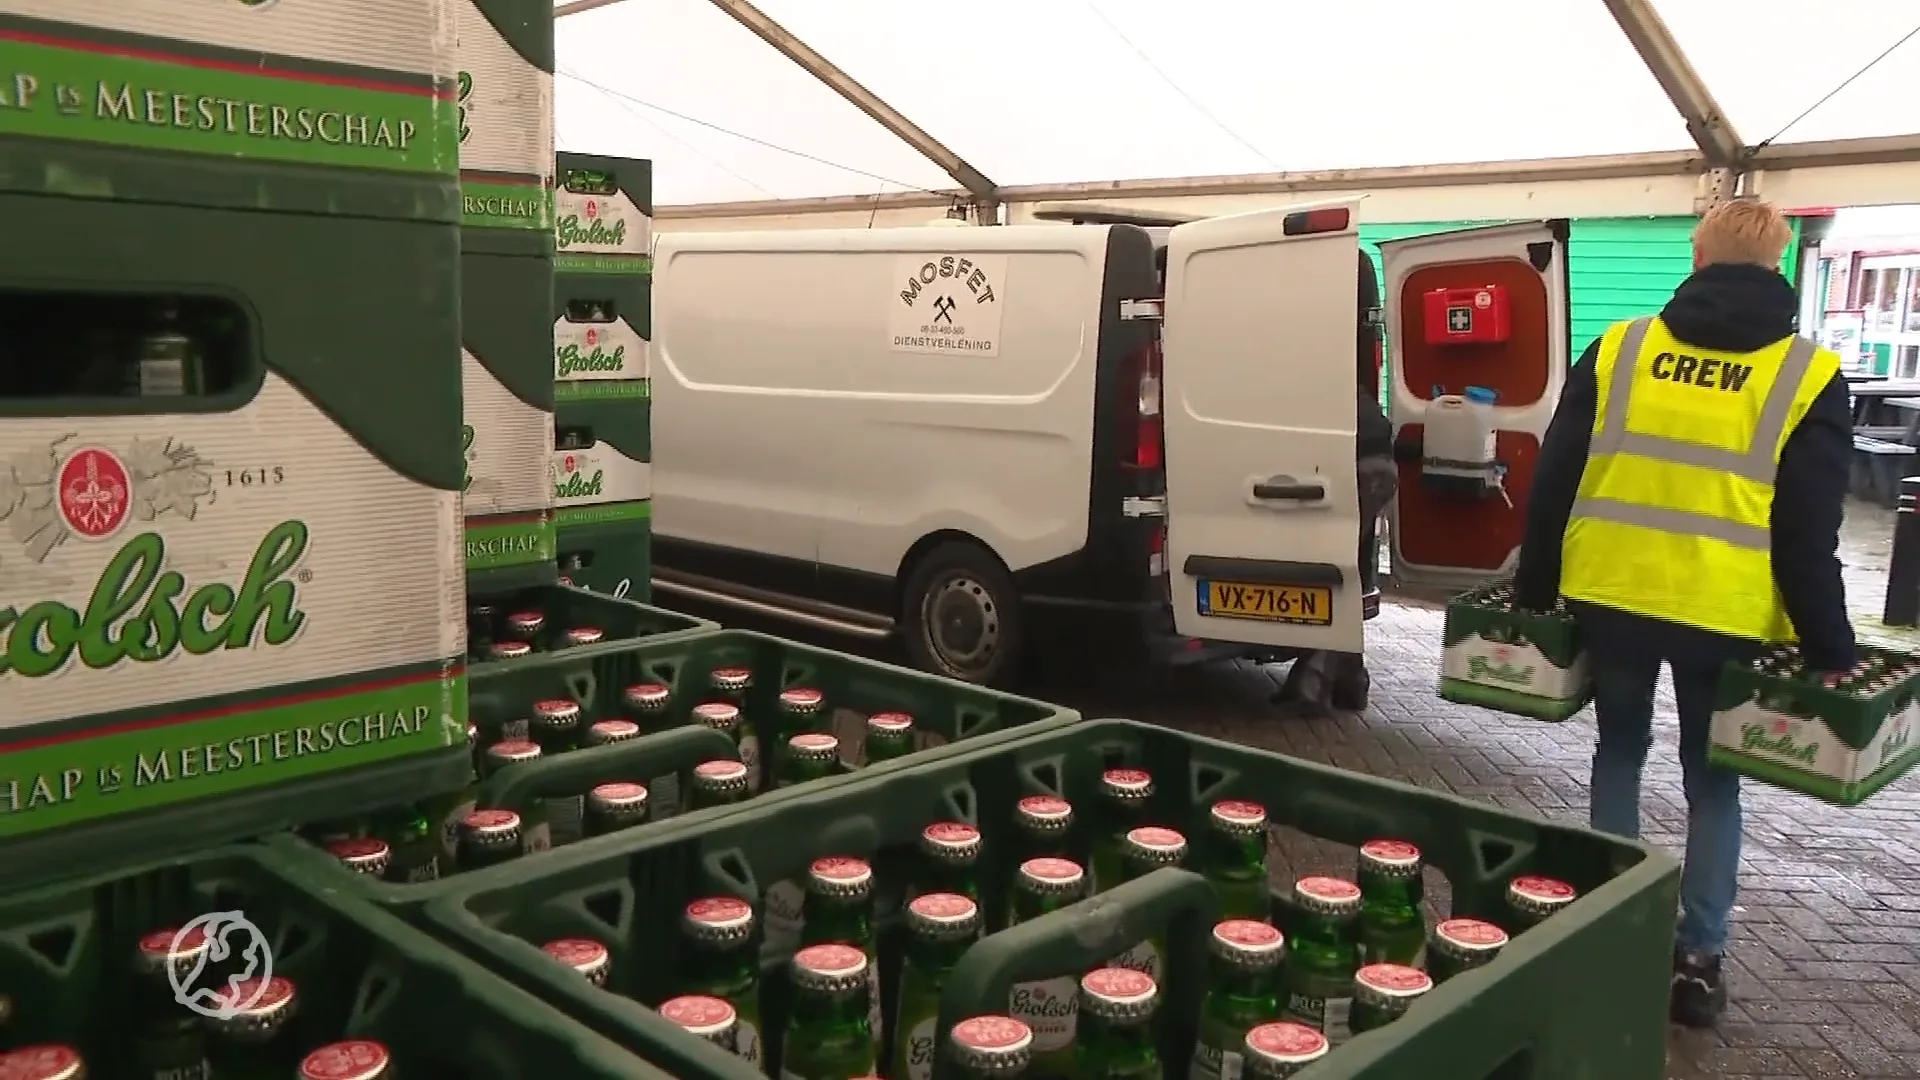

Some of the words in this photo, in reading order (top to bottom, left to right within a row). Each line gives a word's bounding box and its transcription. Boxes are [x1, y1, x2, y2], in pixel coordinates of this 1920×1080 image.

[97, 79, 416, 149] MEESTERSCHAP
[557, 214, 625, 248] Grolsch
[900, 256, 995, 307] MOSFET
[894, 336, 992, 350] DIENSTVERLENING
[557, 344, 624, 377] Grolsch
[1651, 352, 1753, 392] CREW
[224, 466, 284, 488] 1615
[1217, 584, 1317, 615] VX-716-N
[135, 705, 430, 787] MEESTERSCHAP
